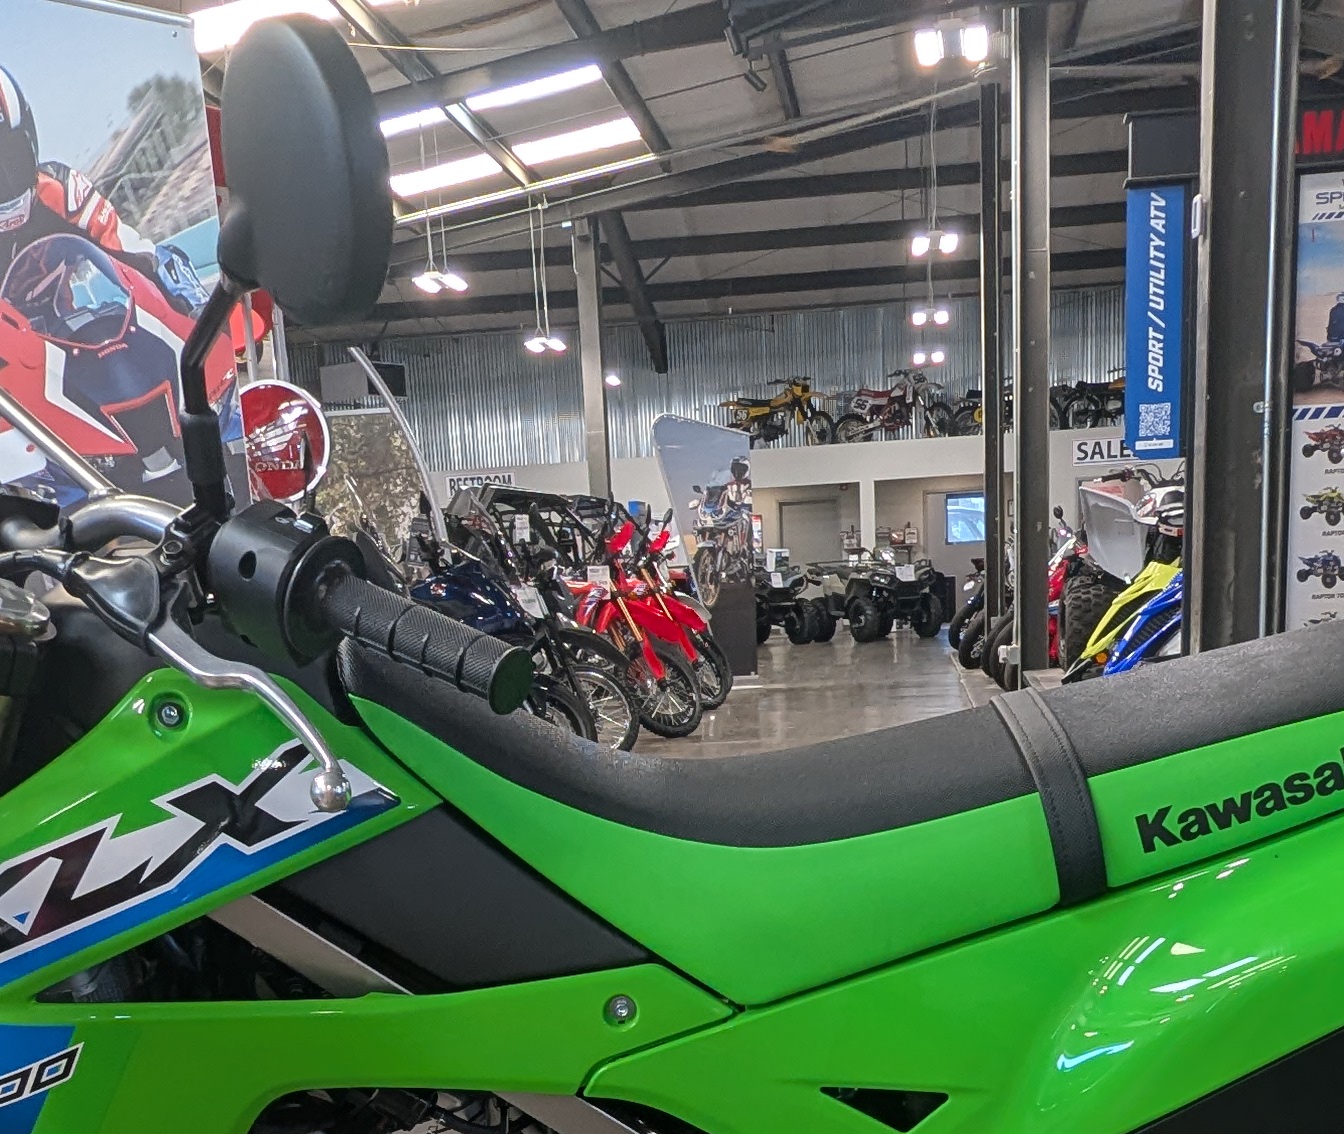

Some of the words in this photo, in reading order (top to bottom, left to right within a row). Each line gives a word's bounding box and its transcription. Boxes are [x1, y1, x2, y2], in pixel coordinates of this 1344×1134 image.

[1149, 191, 1167, 235] ATV
[1148, 232, 1166, 312] UTILITY
[1147, 326, 1165, 393] SPORT
[255, 460, 302, 472] ONDA
[1076, 440, 1139, 462] SALE
